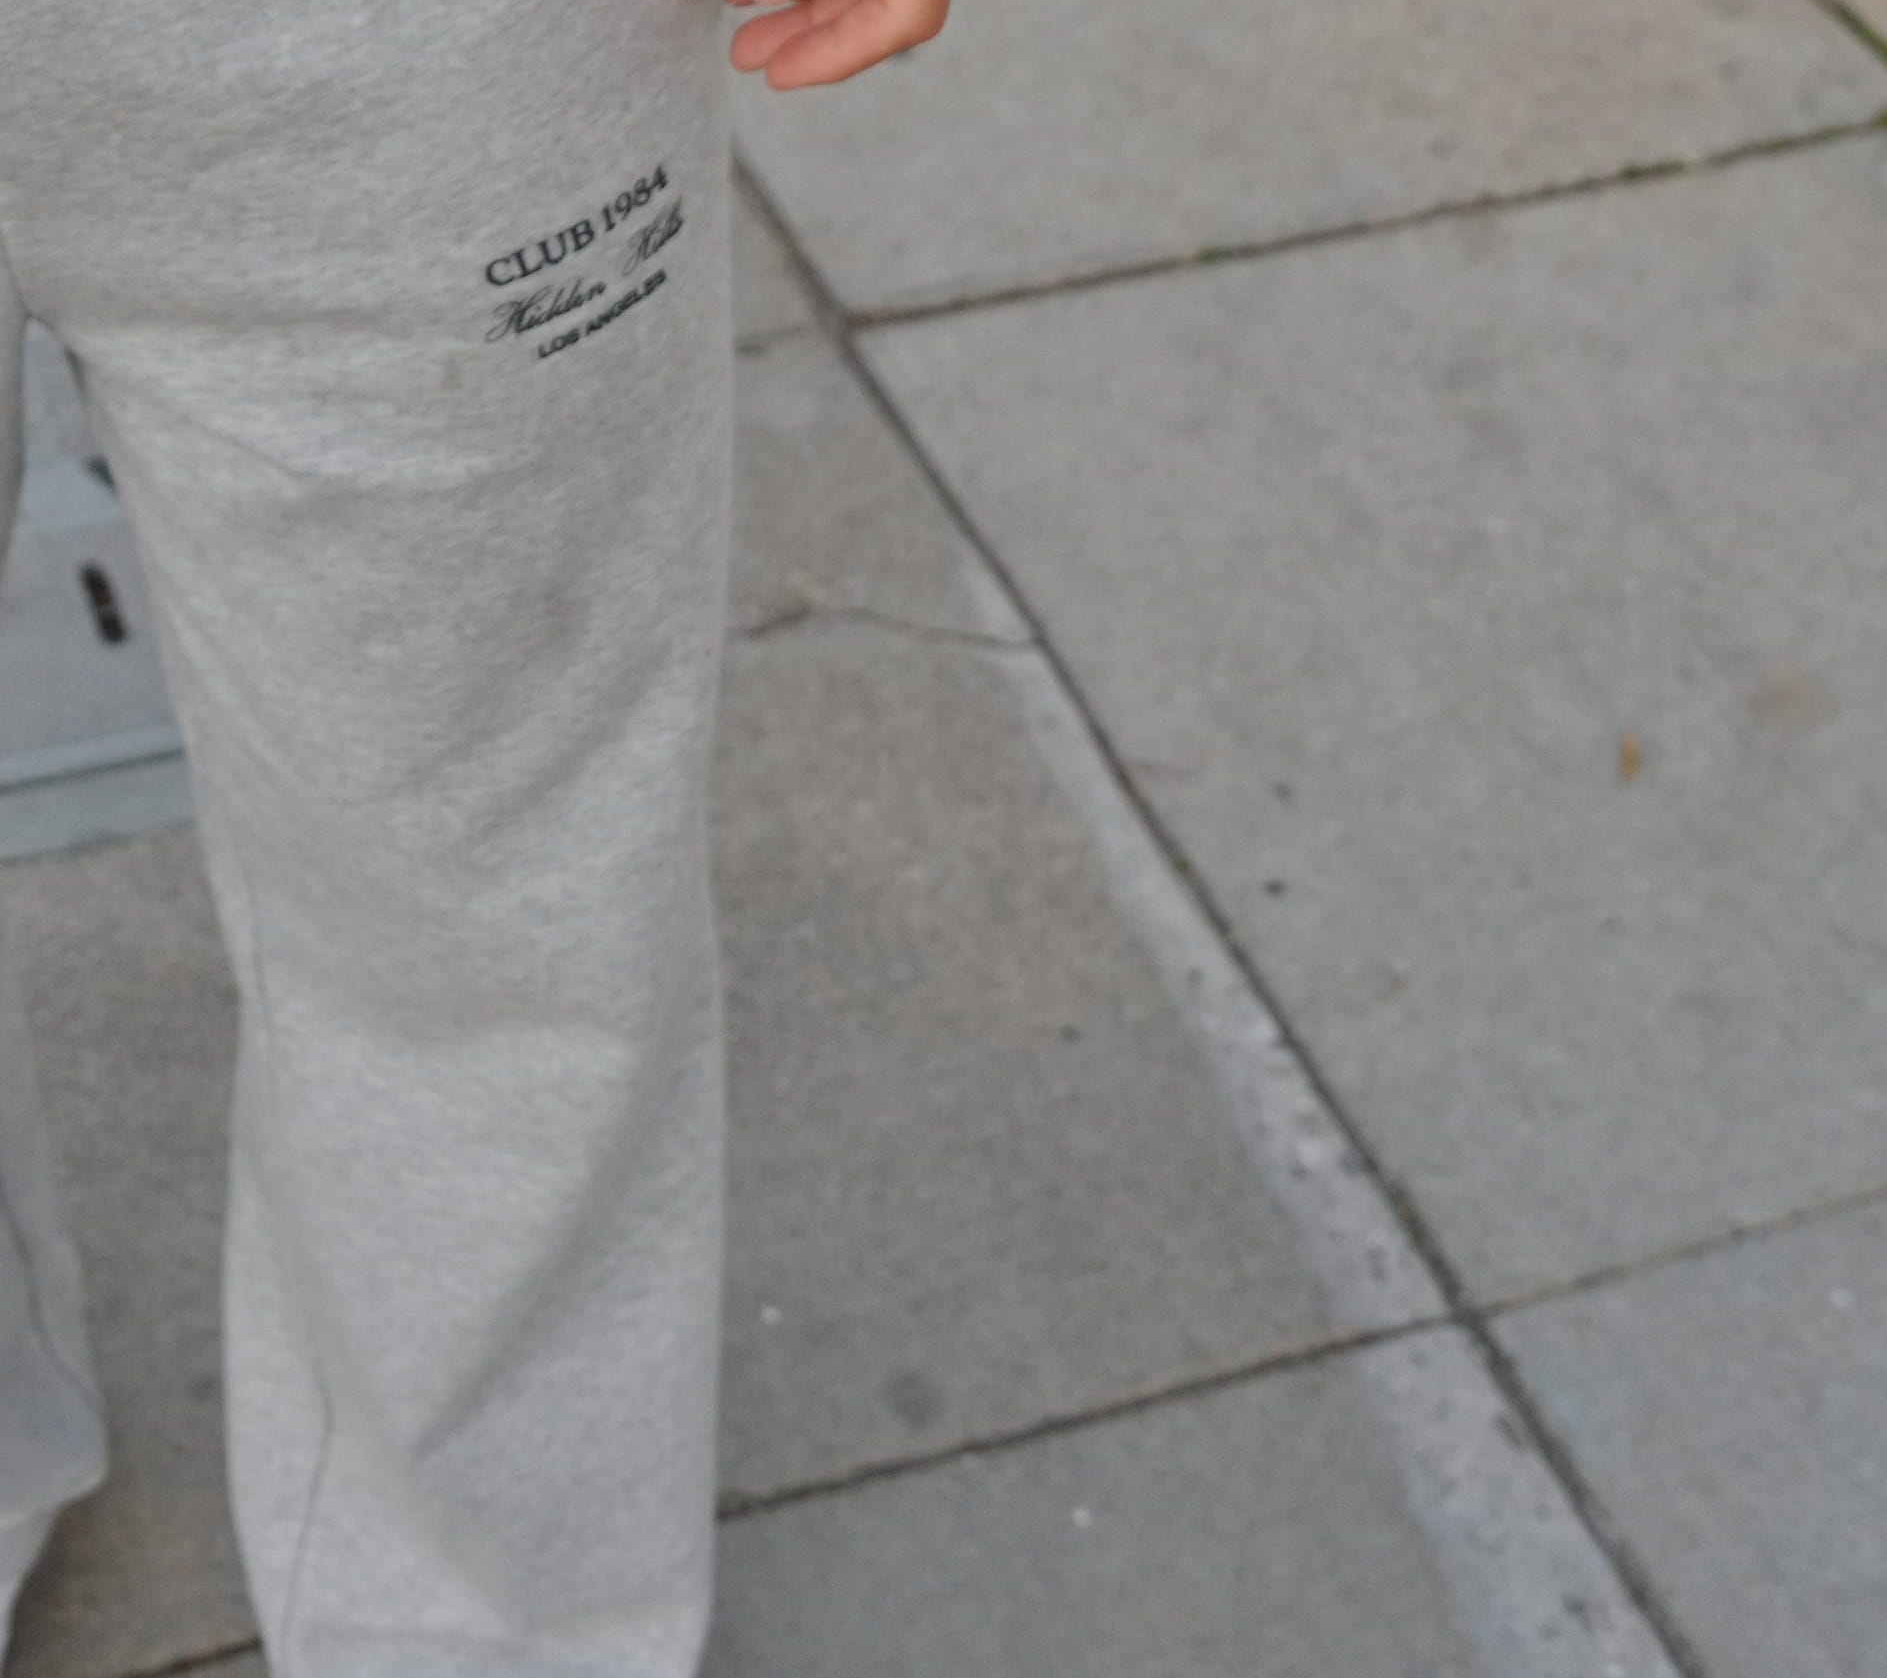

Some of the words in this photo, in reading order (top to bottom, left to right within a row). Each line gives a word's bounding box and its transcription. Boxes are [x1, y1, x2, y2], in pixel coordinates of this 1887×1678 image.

[485, 219, 595, 287] CLUB
[601, 164, 670, 233] 1984
[484, 277, 607, 343] Hidden
[537, 325, 581, 359] LOS
[584, 269, 668, 338] ANGELES
